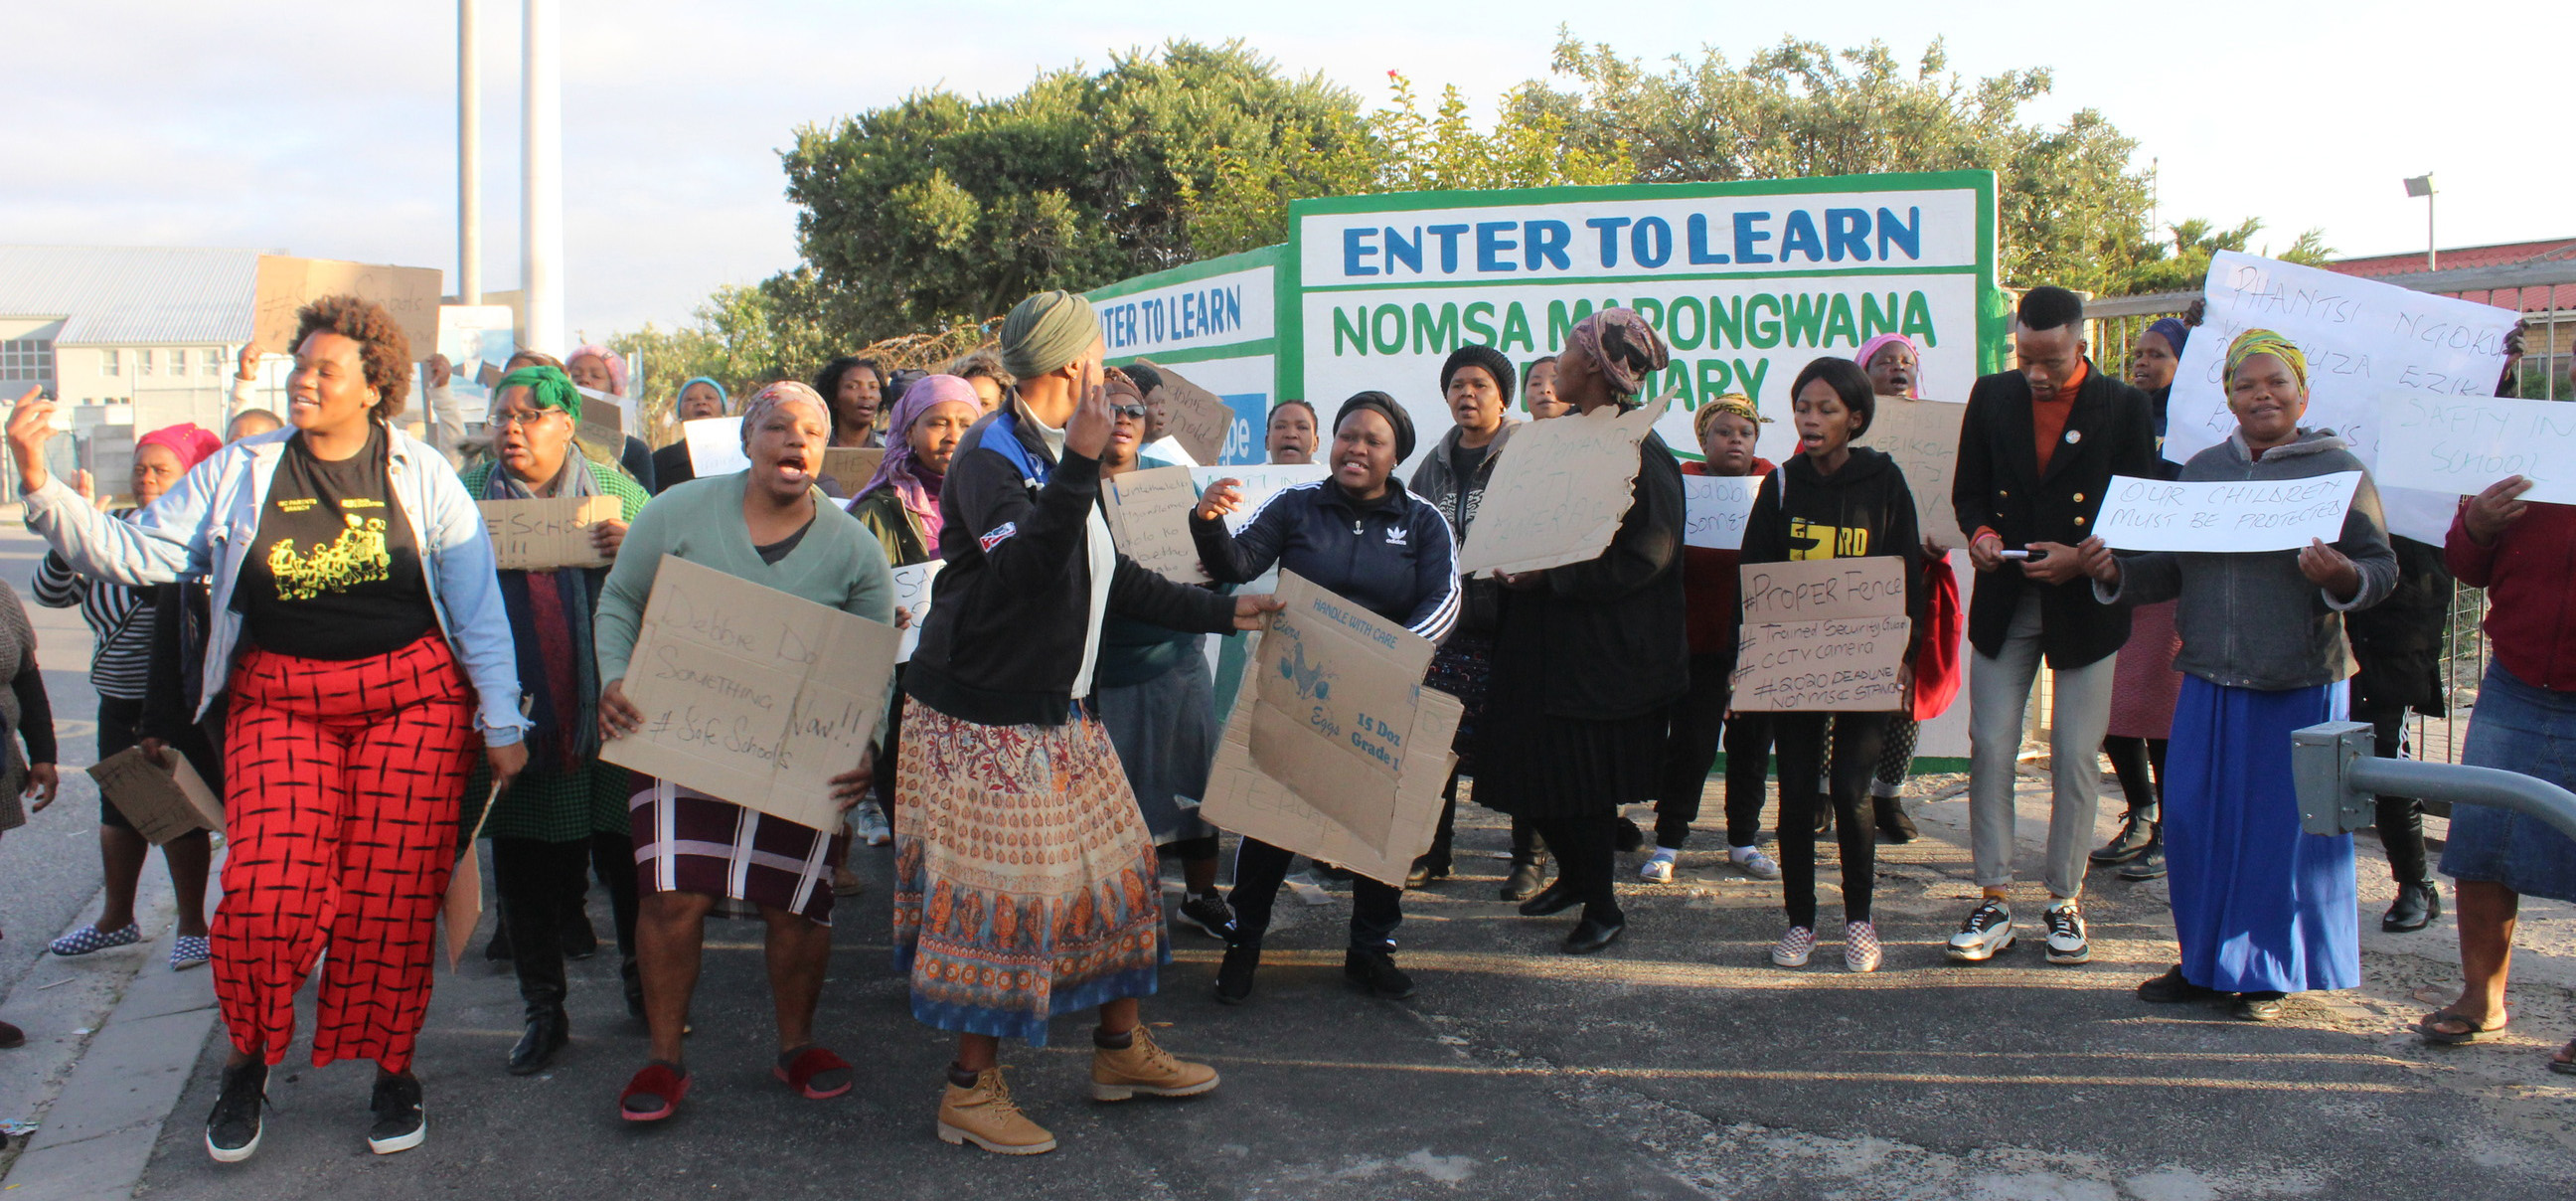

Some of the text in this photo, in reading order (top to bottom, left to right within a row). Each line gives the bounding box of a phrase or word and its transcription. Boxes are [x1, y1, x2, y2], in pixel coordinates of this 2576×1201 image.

[1343, 206, 1920, 276] ENTER TO LEARN
[1100, 283, 1241, 349] TER TO LEARN
[1333, 300, 1534, 357] NOMSA
[2430, 440, 2550, 482] SCHOOL
[2119, 479, 2342, 507] OUR CHILDREN
[2109, 498, 2342, 531] MUST BE PROTECTED
[1313, 598, 1399, 650] HANDLE WITH CARE
[1760, 622, 1819, 644] Trained
[1823, 618, 1880, 638] Security
[1761, 648, 1812, 669] CCTV
[1832, 666, 1894, 685] DEADLINE
[1311, 706, 1341, 738] Eggs
[1358, 712, 1401, 748] 15 Doz
[1351, 731, 1400, 772] Grade 1
